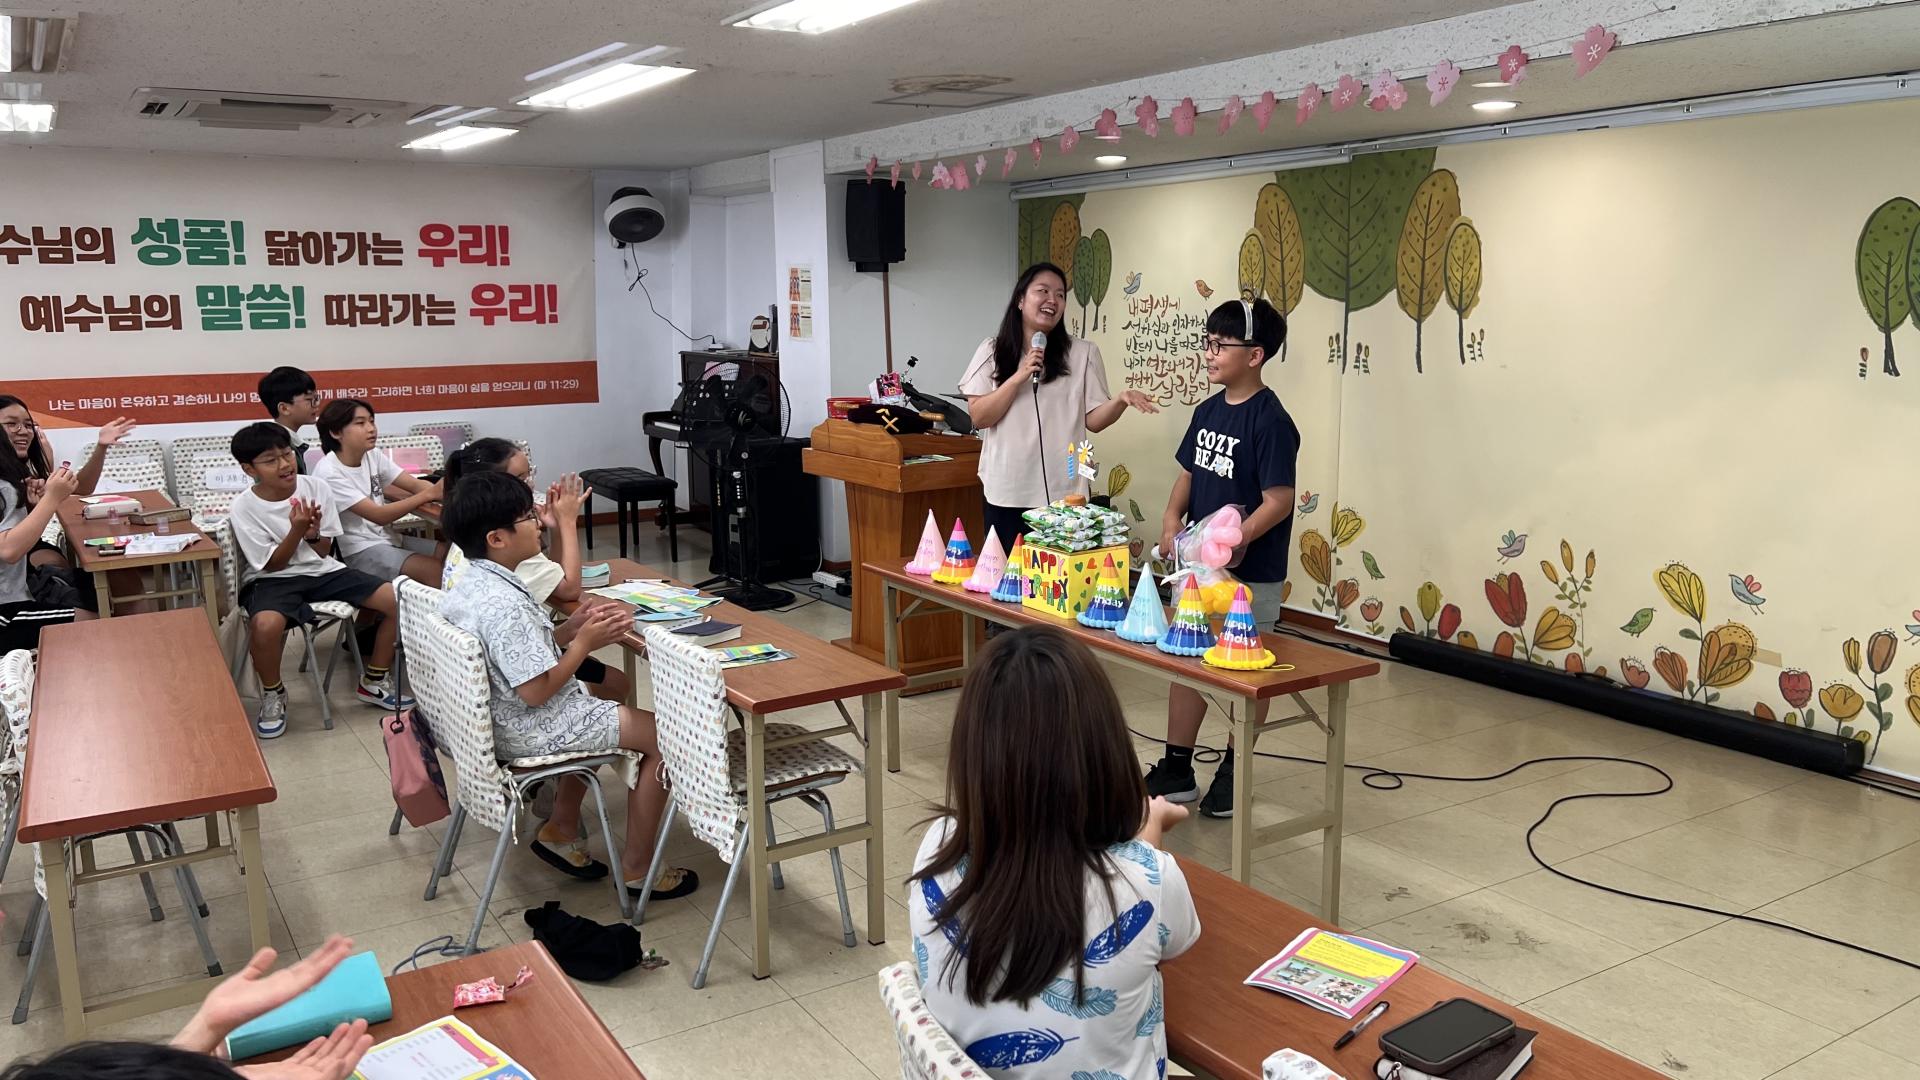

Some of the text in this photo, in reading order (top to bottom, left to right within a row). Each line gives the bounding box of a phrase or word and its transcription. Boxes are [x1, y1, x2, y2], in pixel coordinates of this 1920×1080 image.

[0, 217, 511, 267] 수님의 성품! 닮아가는 우리!
[19, 283, 559, 333] 예수님의 말씀! 따라가는 우리!
[1172, 309, 1209, 335] 인자하심
[48, 399, 75, 411] 나는
[79, 397, 116, 410] 마음이
[121, 394, 169, 408] 온유하고
[172, 393, 220, 406] 겸손하니
[223, 392, 247, 404] 나의
[336, 387, 368, 399] 배우라
[371, 386, 412, 398] 그리하면
[414, 385, 435, 396] 너희
[437, 383, 468, 395] 마음이
[470, 382, 490, 393] 쉼을
[492, 381, 530, 392] 얻으리니
[534, 379, 547, 391] (마
[549, 378, 579, 390] 11:29)
[1196, 428, 1241, 457] COZY
[1194, 446, 1235, 479] BEAR
[1022, 548, 1065, 577] HAPPY
[1021, 574, 1068, 613] BIRTHDAY
